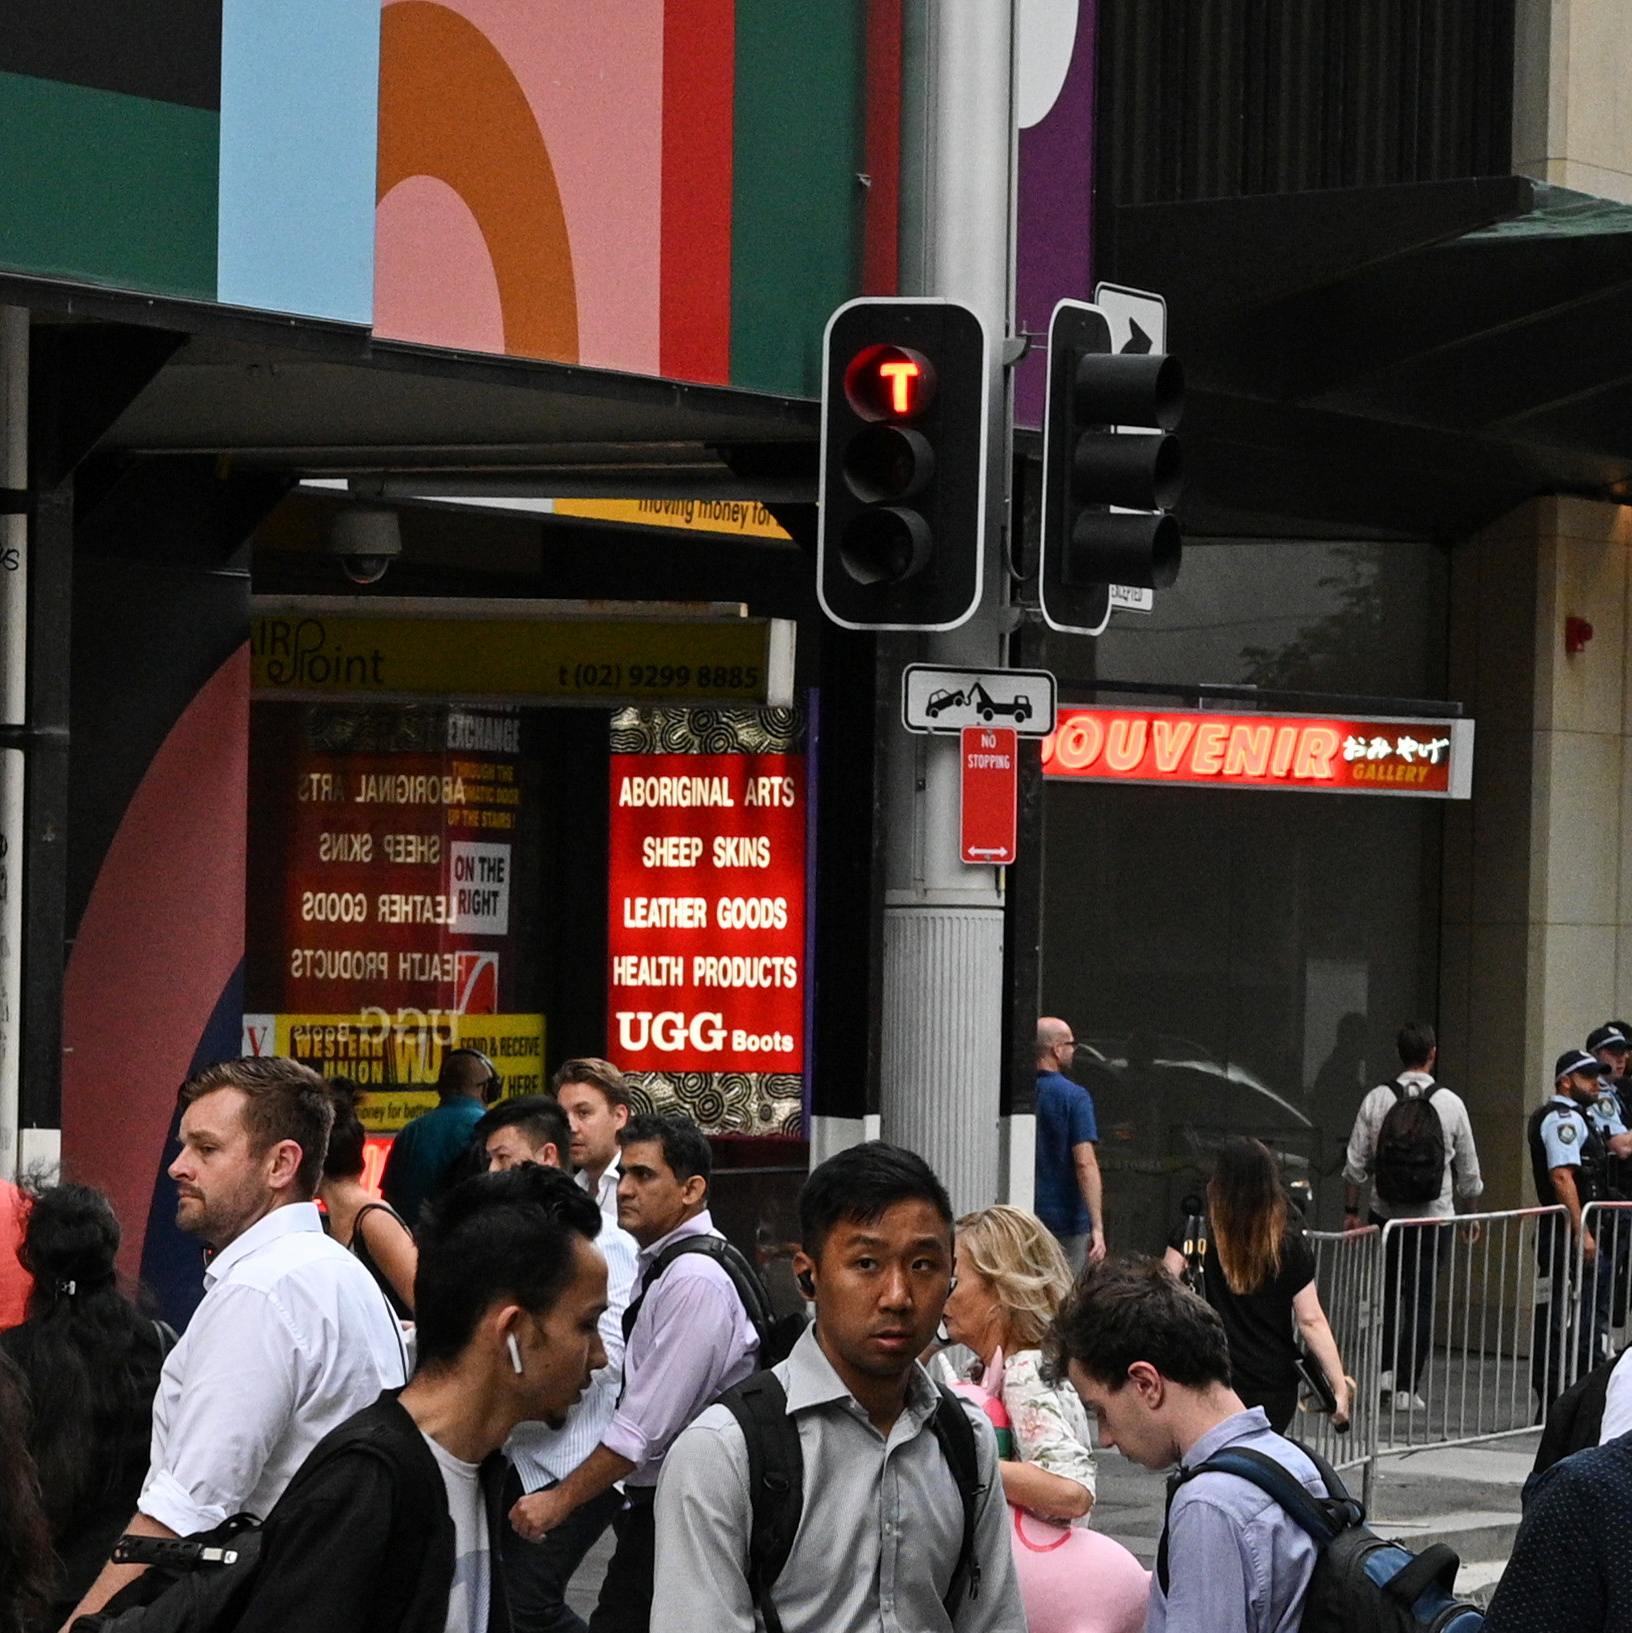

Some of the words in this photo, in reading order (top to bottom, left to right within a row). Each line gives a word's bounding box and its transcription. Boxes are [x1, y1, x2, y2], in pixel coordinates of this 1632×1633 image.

[698, 501, 747, 529] money
[573, 664, 621, 689] (02)
[629, 664, 690, 687] 9299
[697, 665, 758, 688] 8885
[980, 734, 996, 749] NO
[1041, 716, 1340, 779] OUVENIR
[1343, 735, 1450, 764] おみやげ
[967, 754, 1010, 770] STOPPING
[1352, 762, 1429, 783] GALLERY
[619, 776, 734, 808] ABORIGINAL
[744, 776, 795, 808] ARTS
[642, 836, 703, 868] SHEEP
[712, 836, 770, 868] SKINS
[454, 856, 475, 882] ON
[478, 857, 505, 883] THE
[458, 889, 500, 916] RIGHT
[623, 897, 707, 929] LEATHER
[716, 897, 788, 930] GOODS
[613, 955, 684, 986] HEALTH
[693, 956, 797, 988] PRODUCTS
[616, 1011, 727, 1052] UGG
[732, 1029, 794, 1052] Boots
[489, 1037, 498, 1057] &
[499, 1037, 540, 1057] RECEIVE
[508, 1075, 539, 1097] HERE
[357, 1106, 385, 1123] oney
[386, 1102, 401, 1119] for
